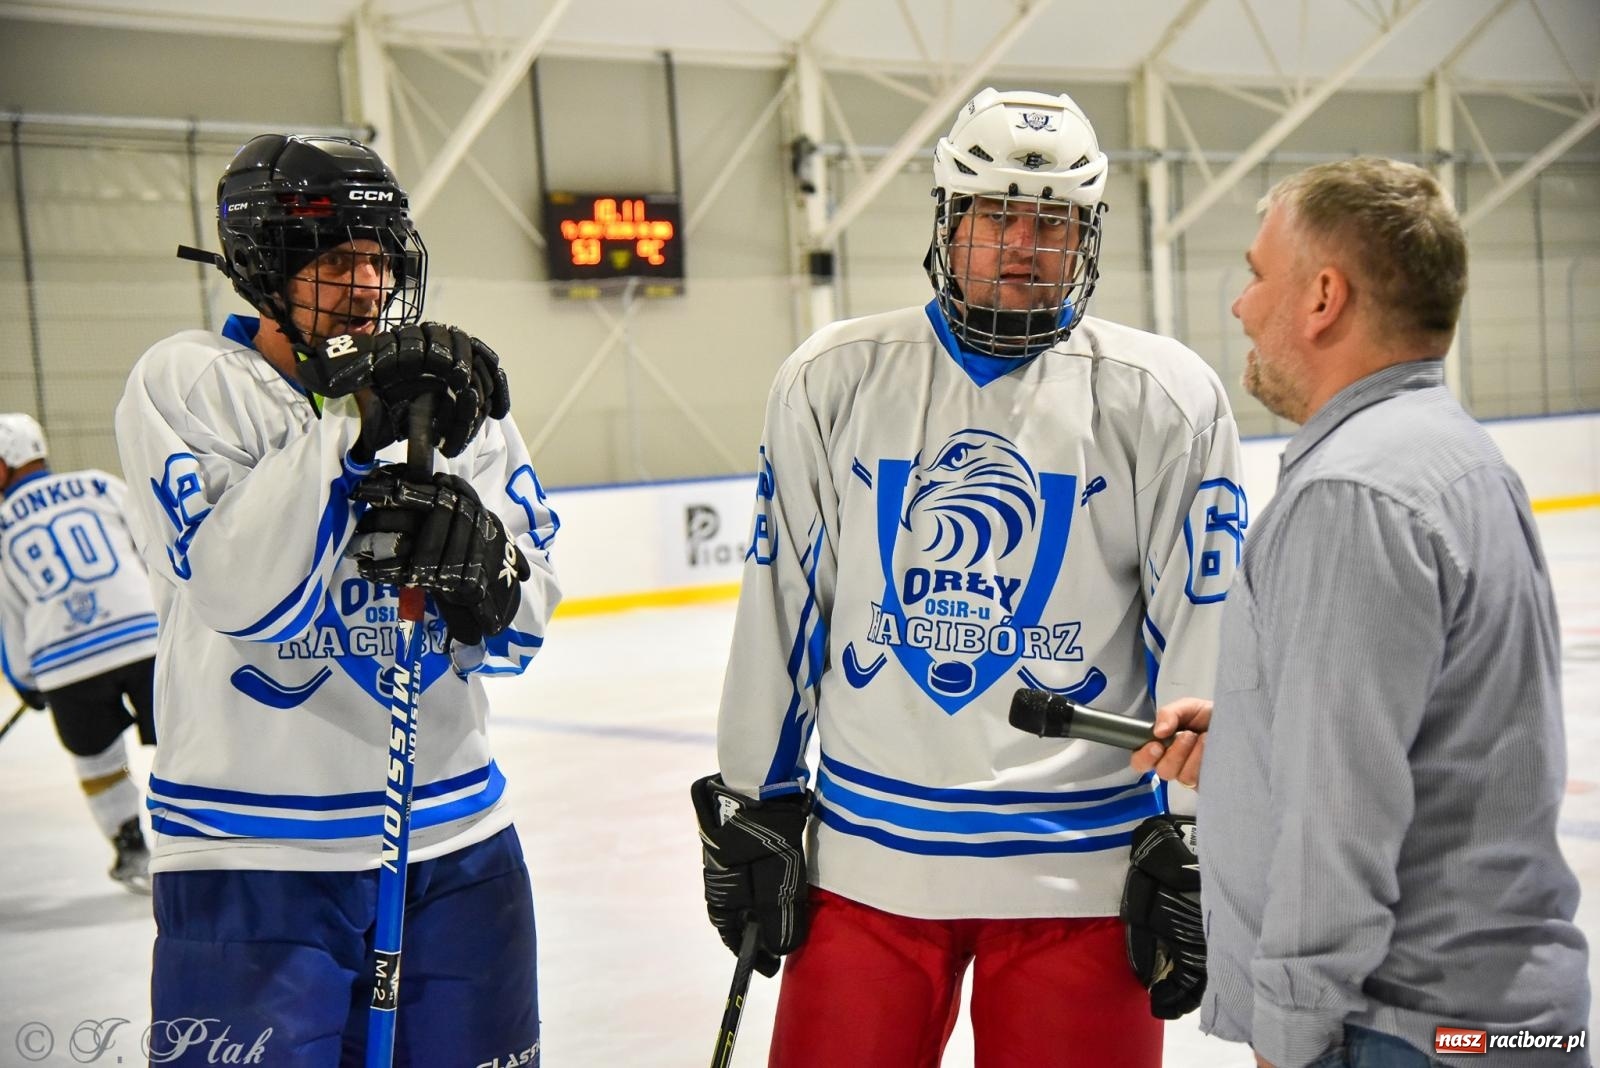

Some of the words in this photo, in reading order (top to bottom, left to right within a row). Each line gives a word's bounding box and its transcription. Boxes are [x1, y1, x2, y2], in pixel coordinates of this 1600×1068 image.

[228, 202, 248, 212] CCM
[349, 190, 393, 201] CCM
[9, 507, 118, 602] 80
[902, 567, 1022, 614] ORŁY
[925, 599, 990, 620] OSiR-u
[365, 606, 400, 624] OSi
[407, 660, 421, 764] MISSION
[380, 662, 410, 874] MISSION
[373, 959, 389, 1001] M-2
